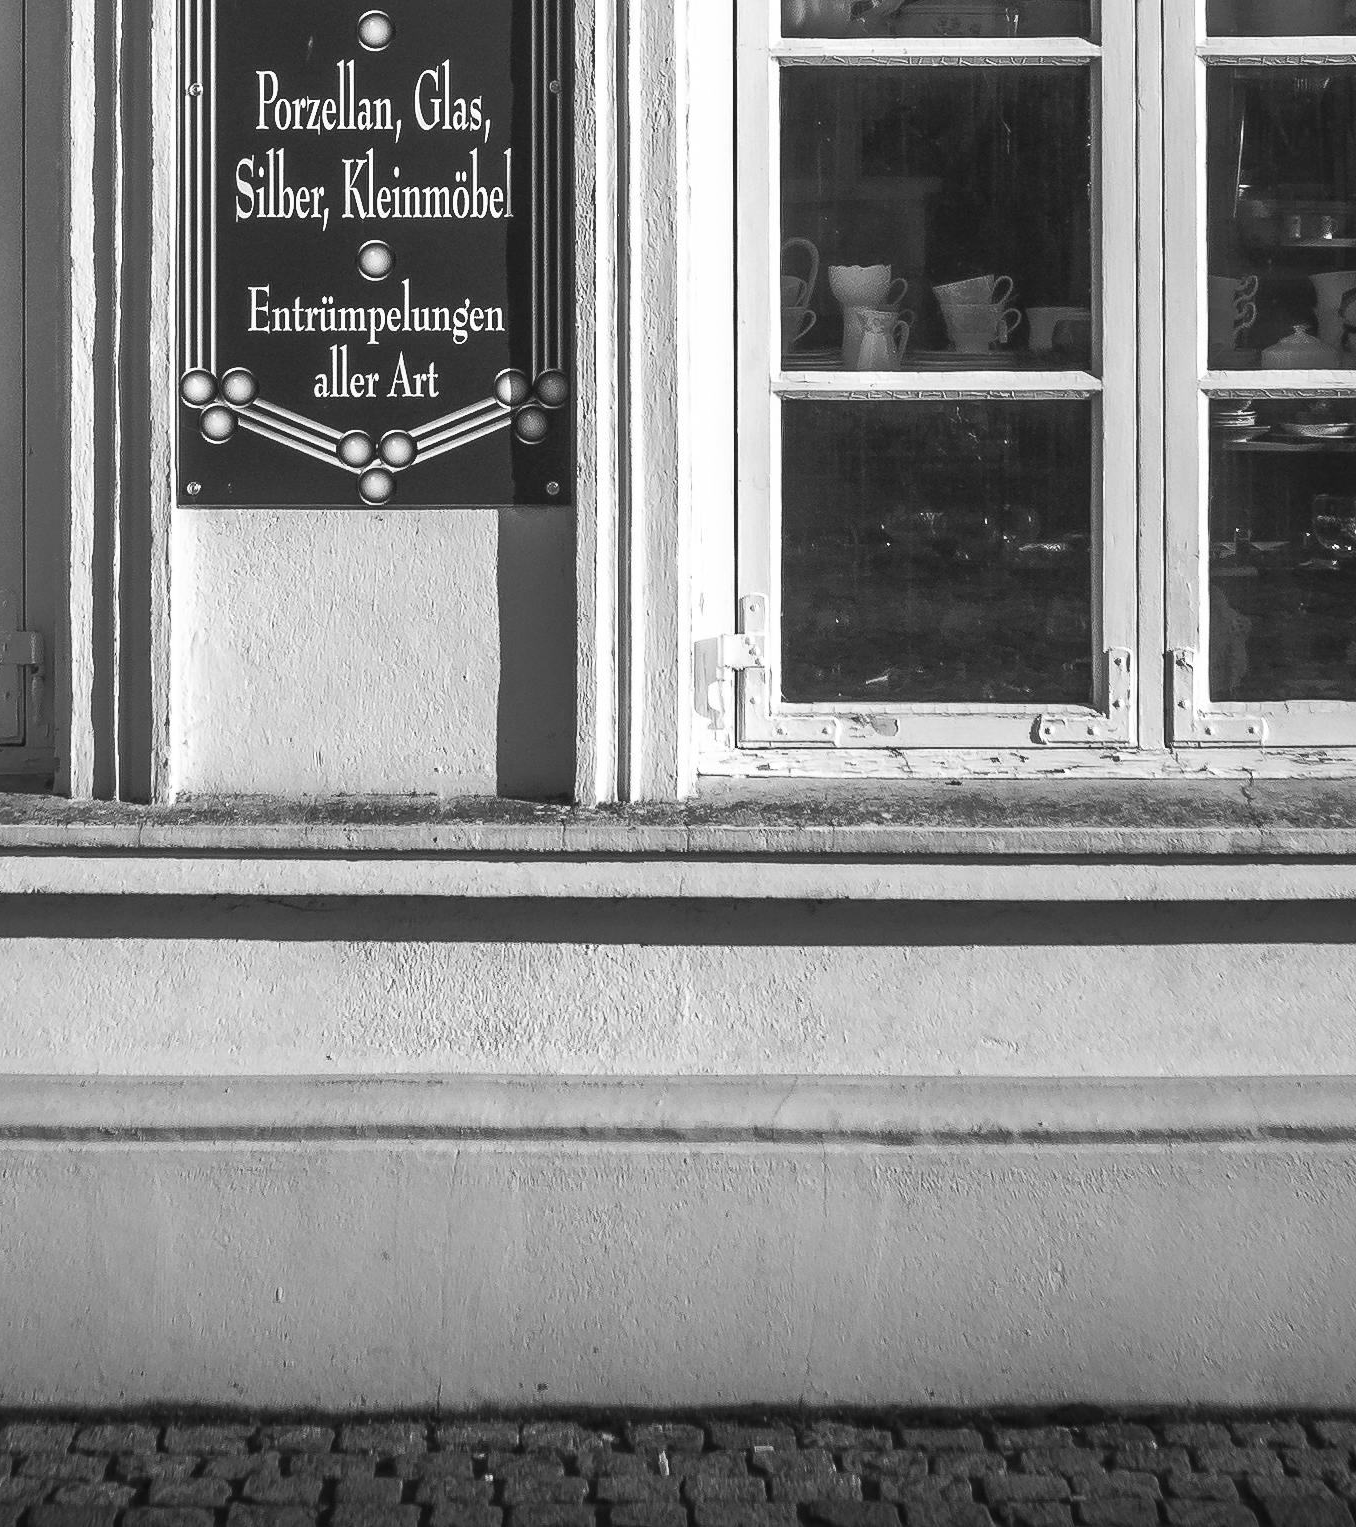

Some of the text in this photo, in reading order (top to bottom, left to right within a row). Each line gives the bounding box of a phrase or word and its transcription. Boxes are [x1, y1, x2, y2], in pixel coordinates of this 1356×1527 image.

[255, 59, 491, 143] Porzellan, Glas,
[235, 147, 513, 231] Silber, Kleinmöbel
[247, 278, 505, 345] Entrümpelungen
[313, 345, 439, 398] aller Art
